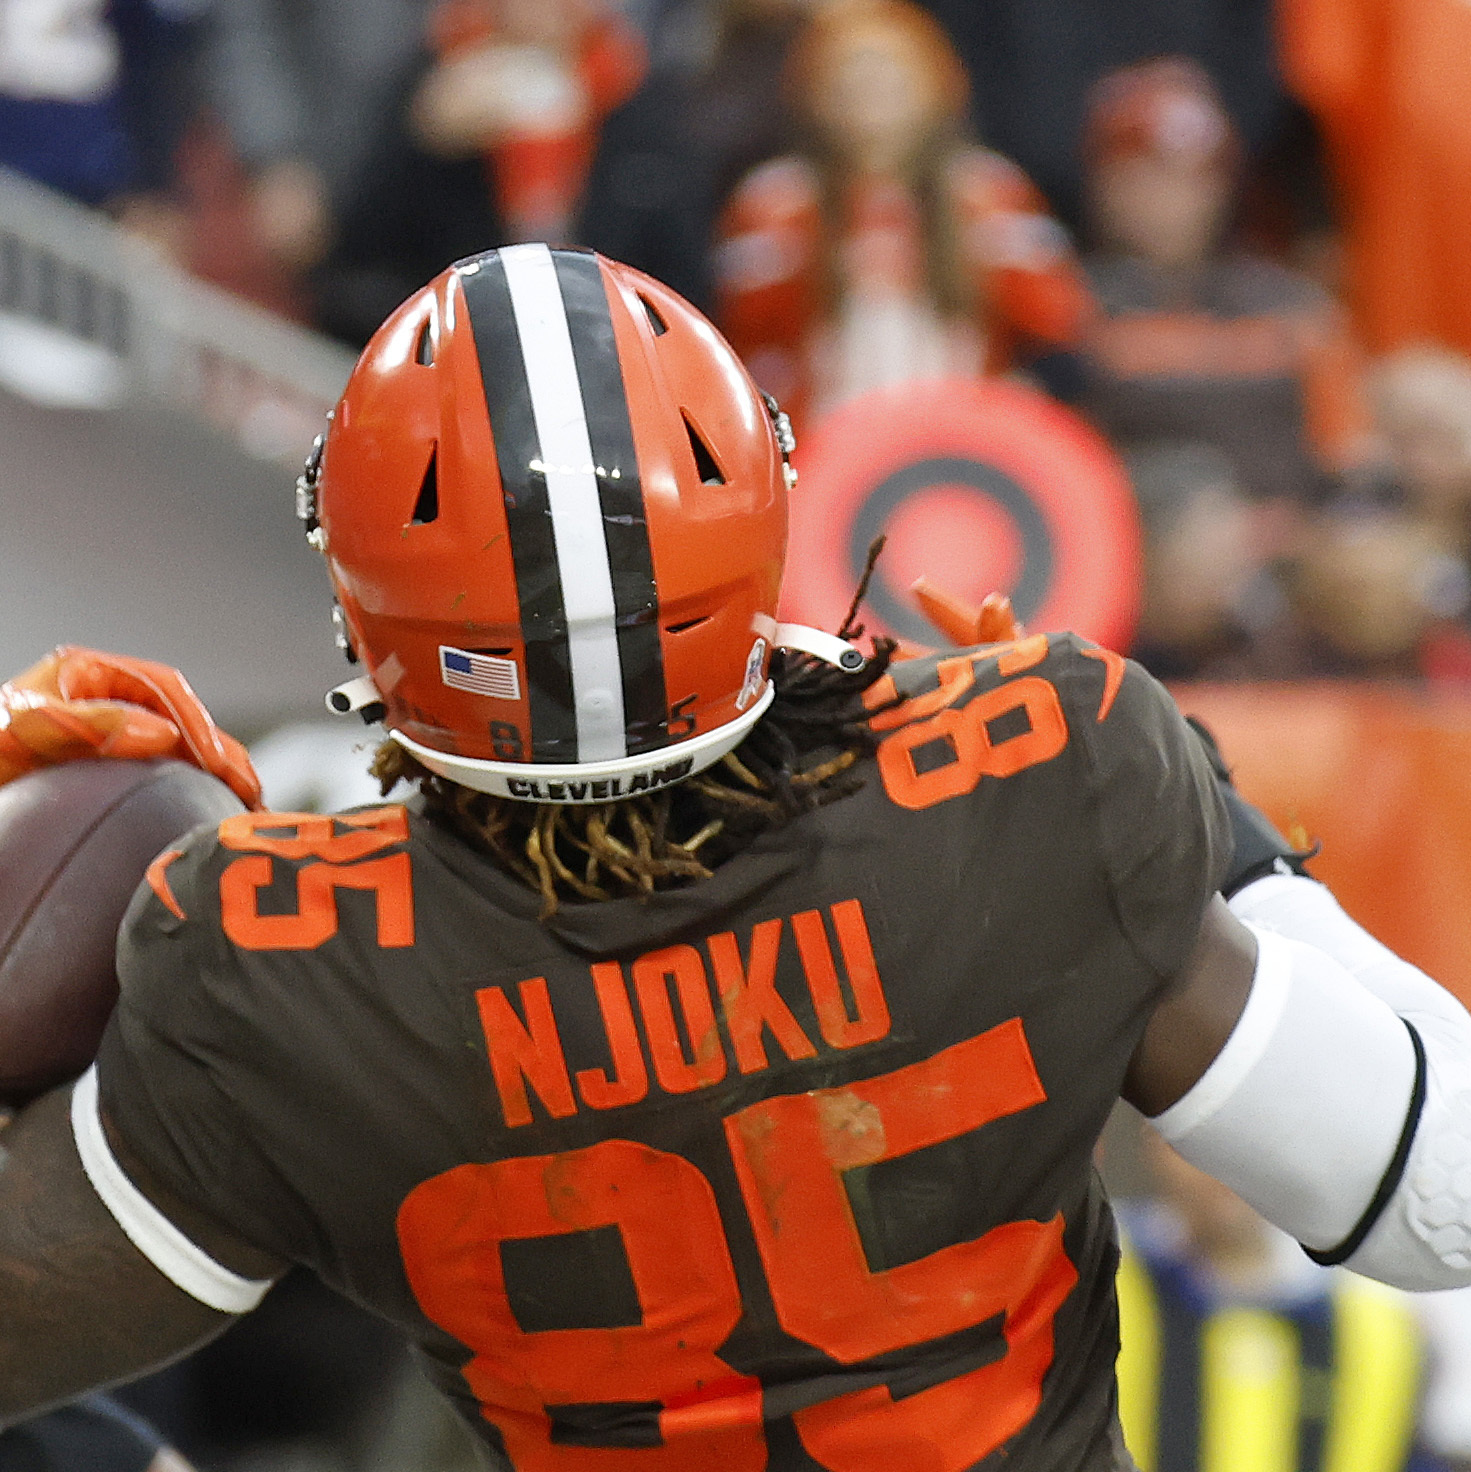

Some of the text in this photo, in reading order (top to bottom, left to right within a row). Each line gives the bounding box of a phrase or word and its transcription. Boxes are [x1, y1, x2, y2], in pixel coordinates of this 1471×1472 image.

[506, 755, 696, 801] CLEVELAND
[861, 634, 1070, 811] 85
[218, 803, 416, 951] 85
[474, 897, 892, 1128] NJOKU
